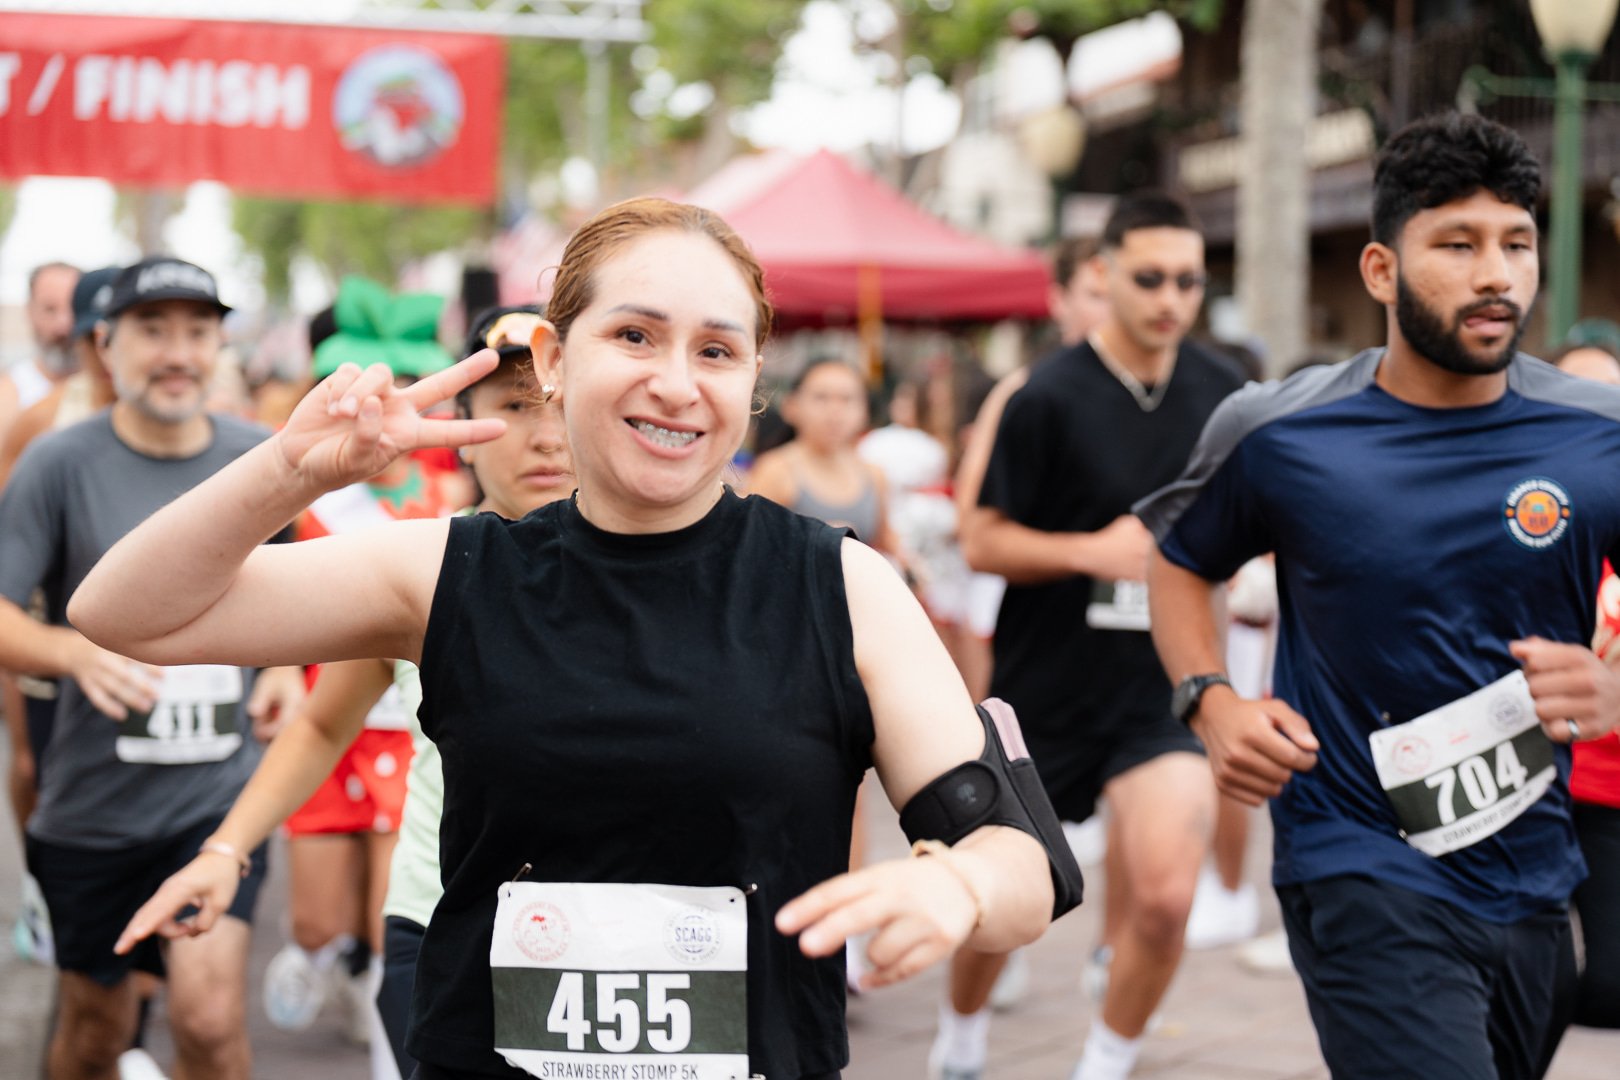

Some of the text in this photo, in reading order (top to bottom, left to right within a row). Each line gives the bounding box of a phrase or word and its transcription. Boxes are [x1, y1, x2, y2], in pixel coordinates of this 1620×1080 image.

[74, 53, 310, 130] FINISH
[147, 699, 217, 743] 411
[1424, 739, 1528, 826] 704
[675, 926, 711, 942] SCAGG
[547, 972, 692, 1053] 455
[542, 1061, 699, 1080] STRAWBERRY STOMP 5K
